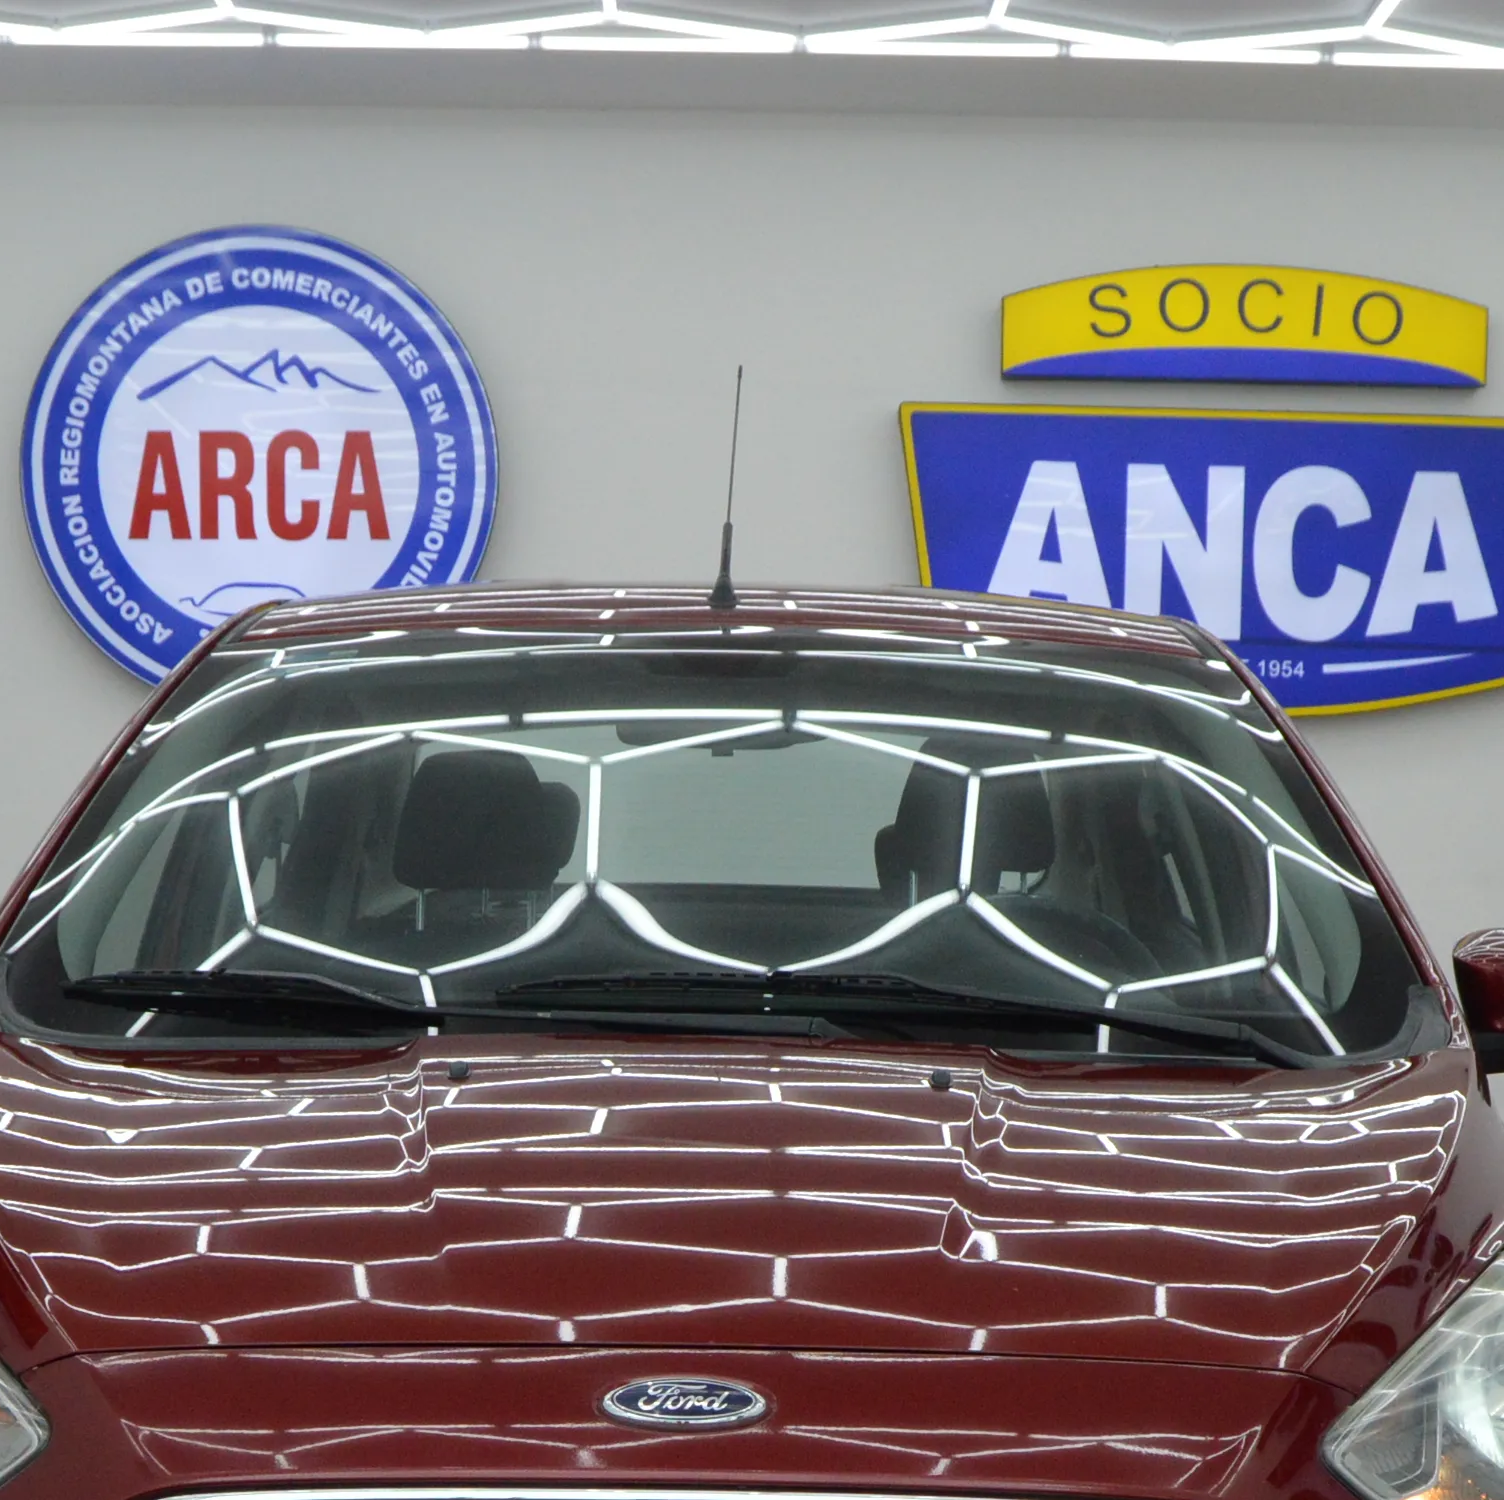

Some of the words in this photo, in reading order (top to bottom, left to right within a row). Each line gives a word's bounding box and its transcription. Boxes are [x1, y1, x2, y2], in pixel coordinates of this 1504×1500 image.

[184, 271, 224, 300] DE
[231, 266, 429, 380] COMERCIANTES
[1087, 277, 1404, 346] SOCIO
[60, 288, 183, 486] REGIOMONTANA
[419, 383, 449, 424] EN
[128, 429, 391, 541] ARCA
[62, 494, 173, 644] ASOCIACION
[987, 459, 1499, 643] ANCA
[1257, 659, 1305, 678] 1954
[637, 1381, 730, 1411] Ford
